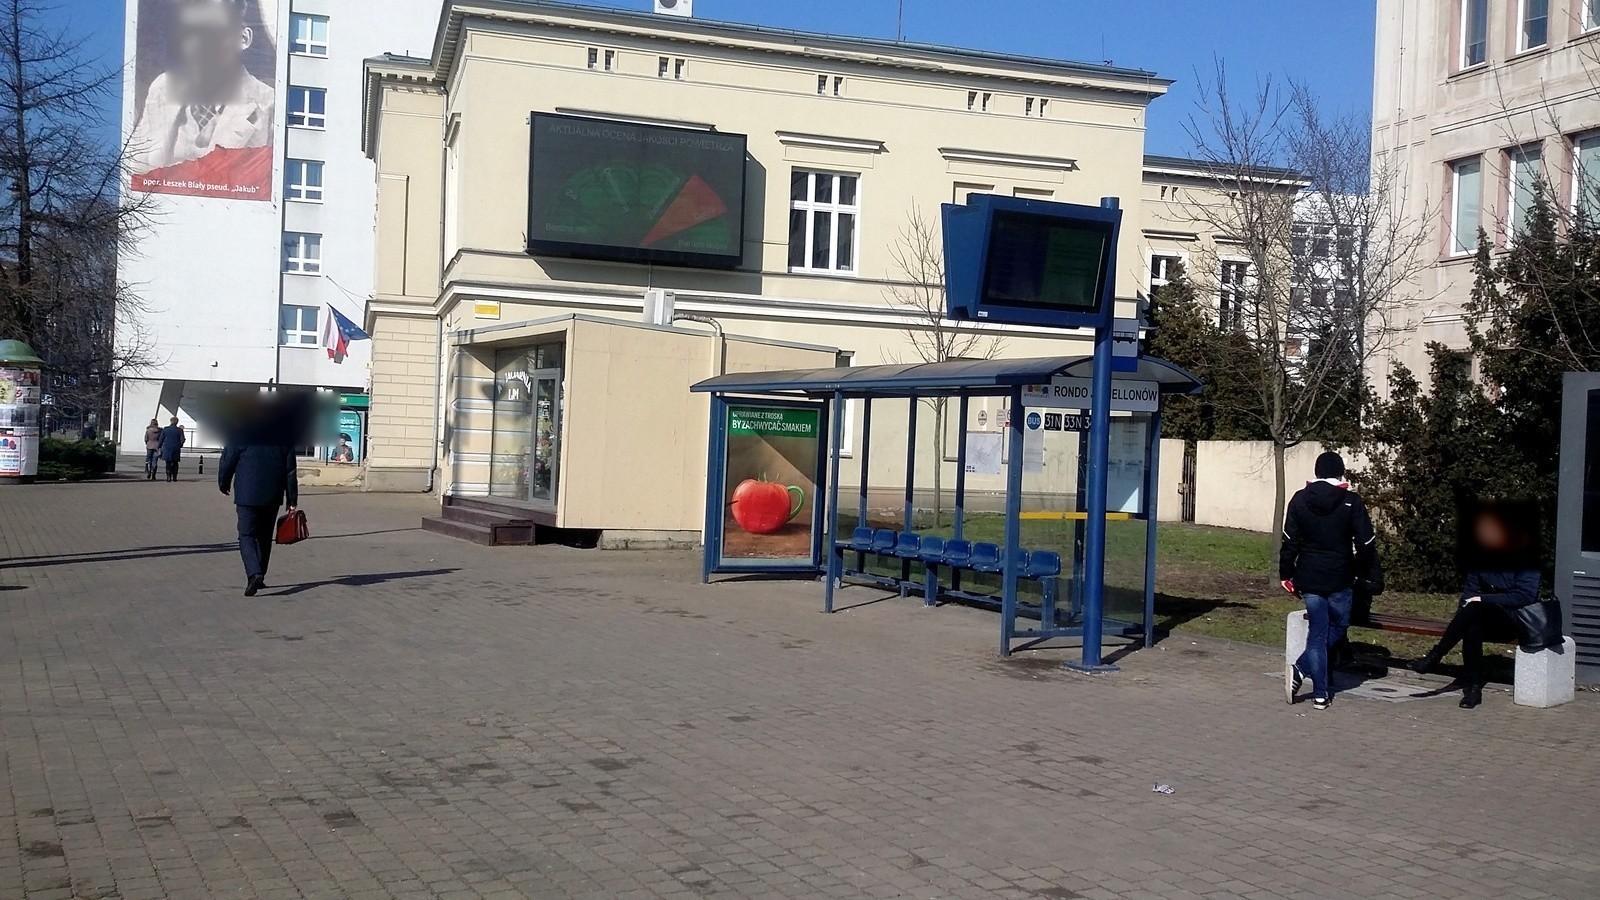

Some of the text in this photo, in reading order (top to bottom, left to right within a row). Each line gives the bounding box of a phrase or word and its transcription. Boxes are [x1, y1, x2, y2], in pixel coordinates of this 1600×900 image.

[163, 179, 186, 188] Leszek
[206, 183, 230, 192] pseud.
[1054, 386, 1088, 398] RONDO
[732, 420, 812, 432] BY ZACHWYCAĆ SMAKIEM
[1027, 417, 1040, 425] BUS
[1045, 414, 1061, 428] 31N
[1064, 416, 1082, 428] 33N
